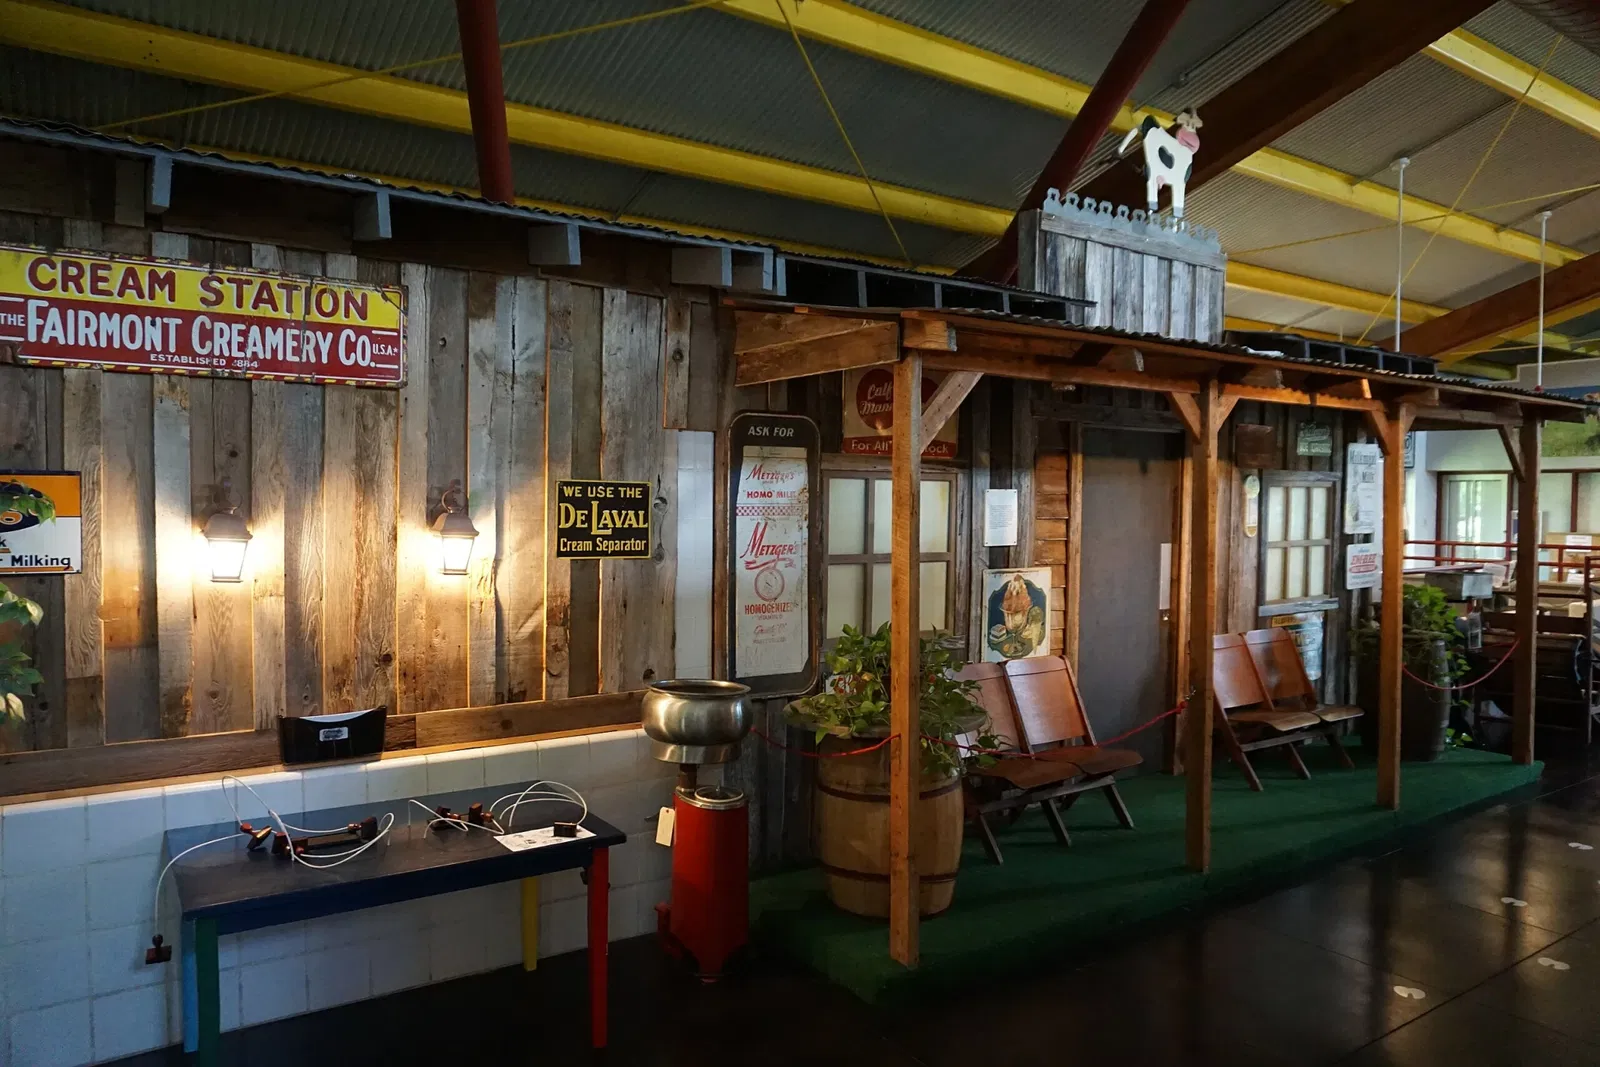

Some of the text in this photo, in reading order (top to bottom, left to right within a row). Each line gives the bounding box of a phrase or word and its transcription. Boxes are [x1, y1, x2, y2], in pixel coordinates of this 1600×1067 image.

[27, 256, 369, 321] CREAM STATION
[0, 313, 26, 326] THE
[28, 299, 183, 353] FAIRMONT
[191, 315, 334, 364] CREAMERY
[150, 353, 226, 366] ESTABLISHED
[748, 426, 794, 437] ASK FOR
[851, 439, 871, 450] For
[874, 440, 888, 451] All
[563, 486, 643, 498] WE USE THE
[560, 537, 647, 554] Cream Separator
[11, 554, 71, 571] Milking
